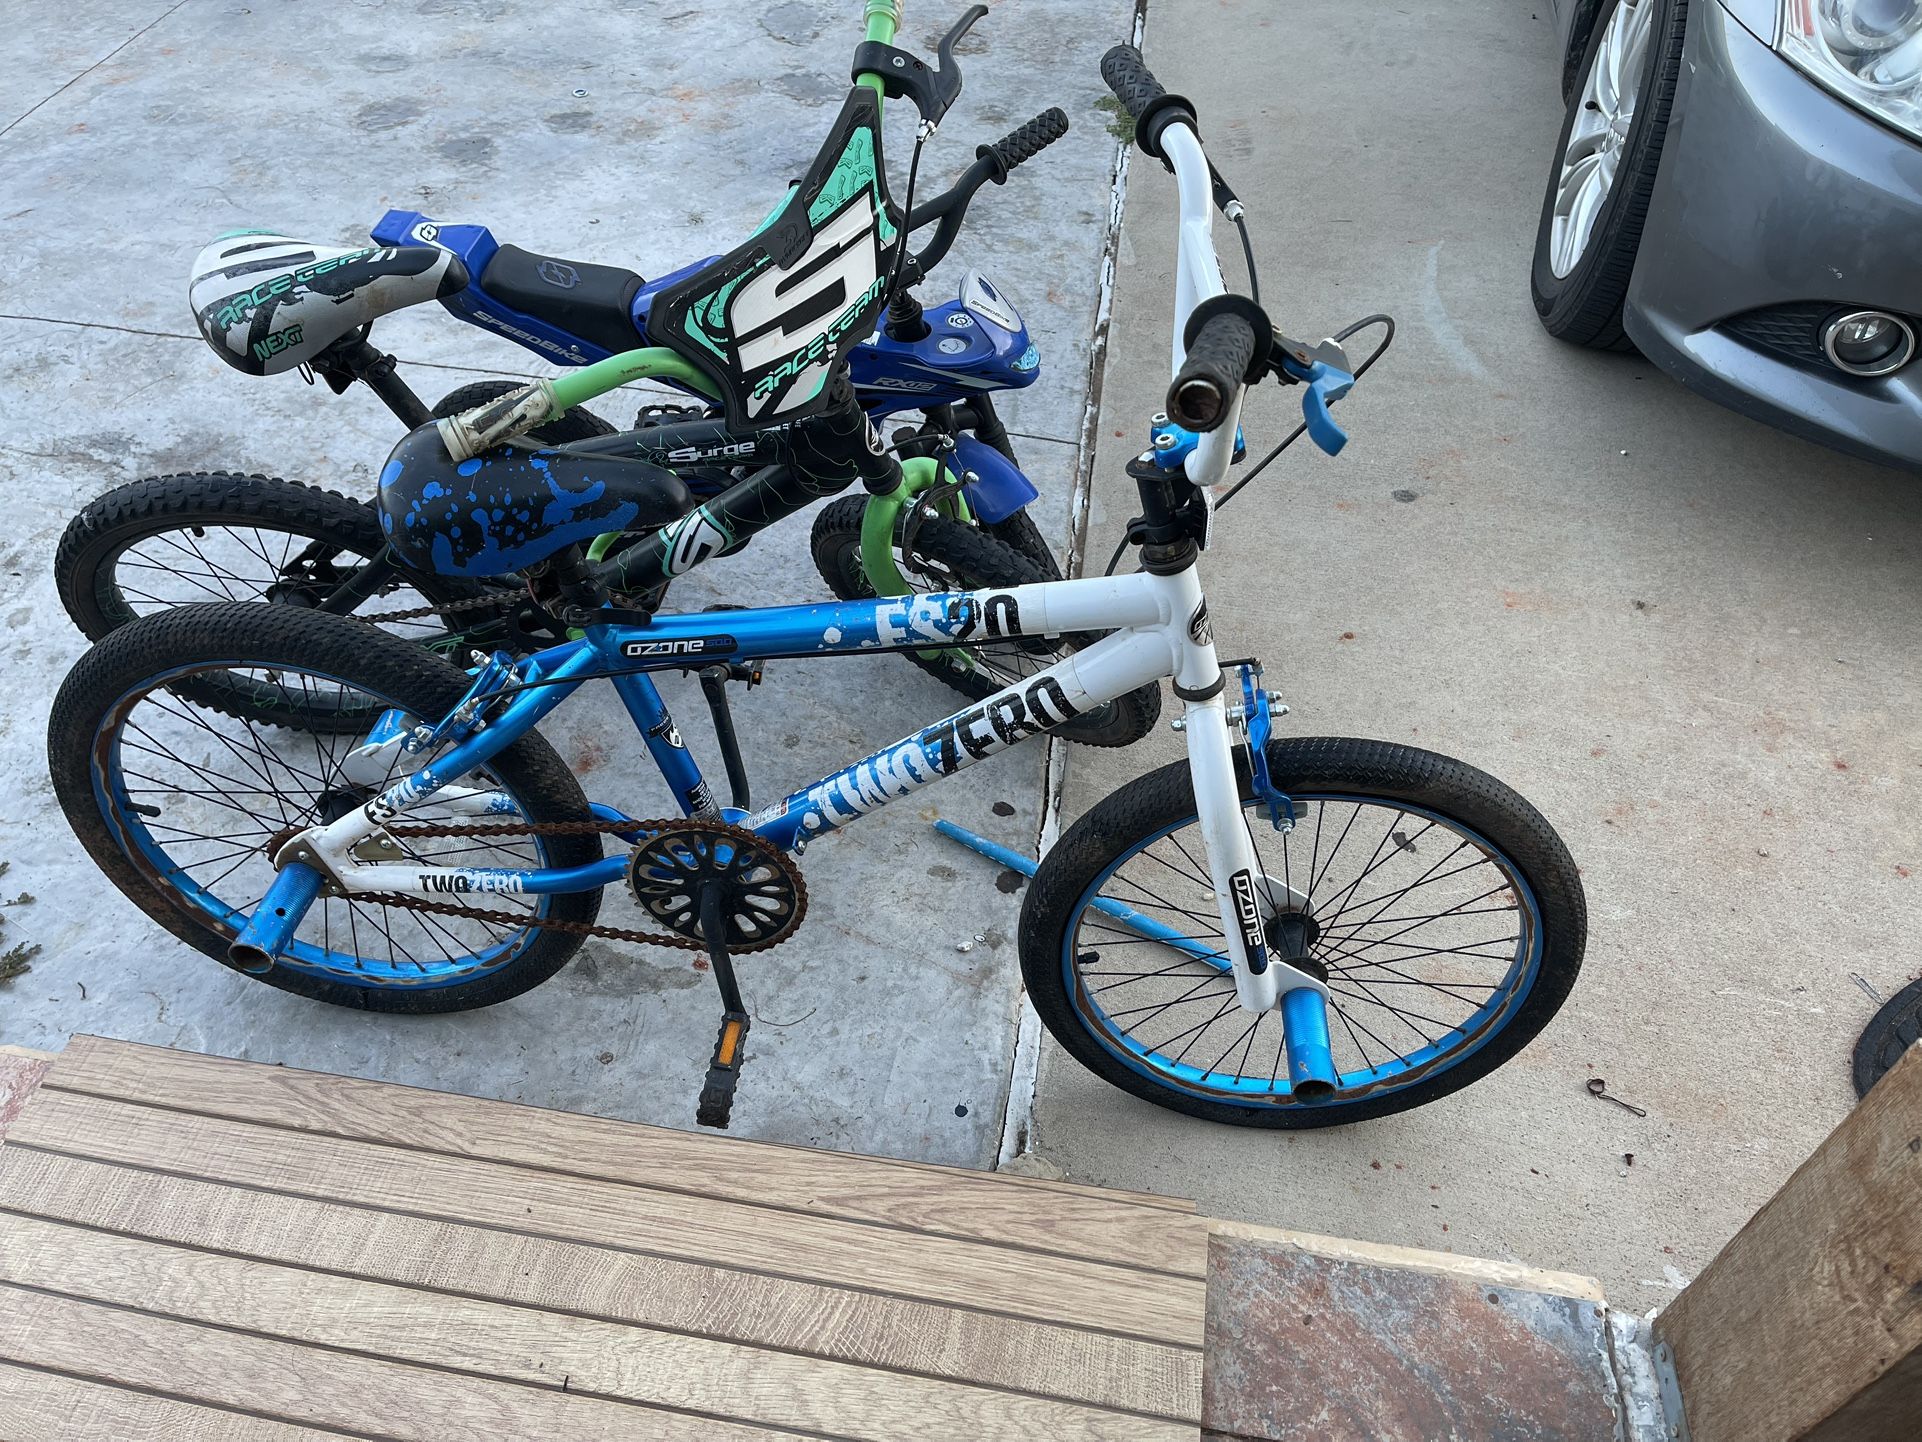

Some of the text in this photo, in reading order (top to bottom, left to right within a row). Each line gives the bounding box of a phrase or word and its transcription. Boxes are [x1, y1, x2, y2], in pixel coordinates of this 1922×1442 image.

[217, 275, 291, 329] RACE
[253, 326, 304, 361] NEXT
[754, 333, 825, 398] RACE
[668, 441, 756, 462] Surge
